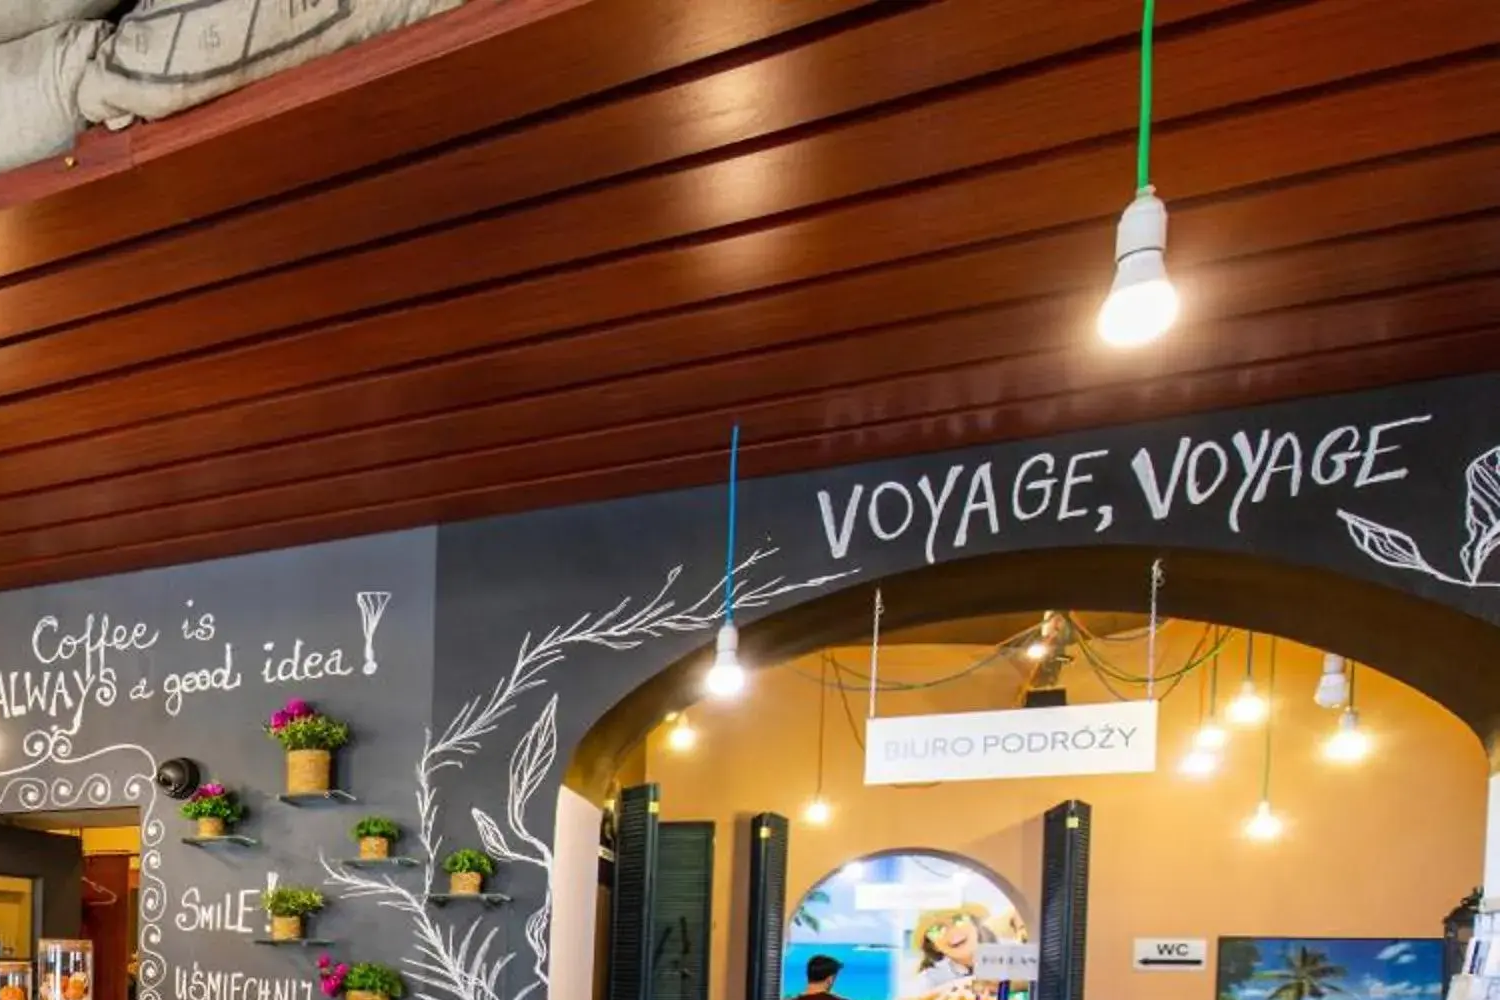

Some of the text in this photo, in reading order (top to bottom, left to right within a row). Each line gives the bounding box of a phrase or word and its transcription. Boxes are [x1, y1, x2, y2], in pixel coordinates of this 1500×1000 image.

[816, 414, 1433, 564] VOYAGE, VOYAGE
[32, 598, 215, 682] Coffee is
[129, 677, 154, 700] a
[163, 642, 242, 717] good
[884, 736, 975, 762] BIURO
[1156, 943, 1189, 957] WC
